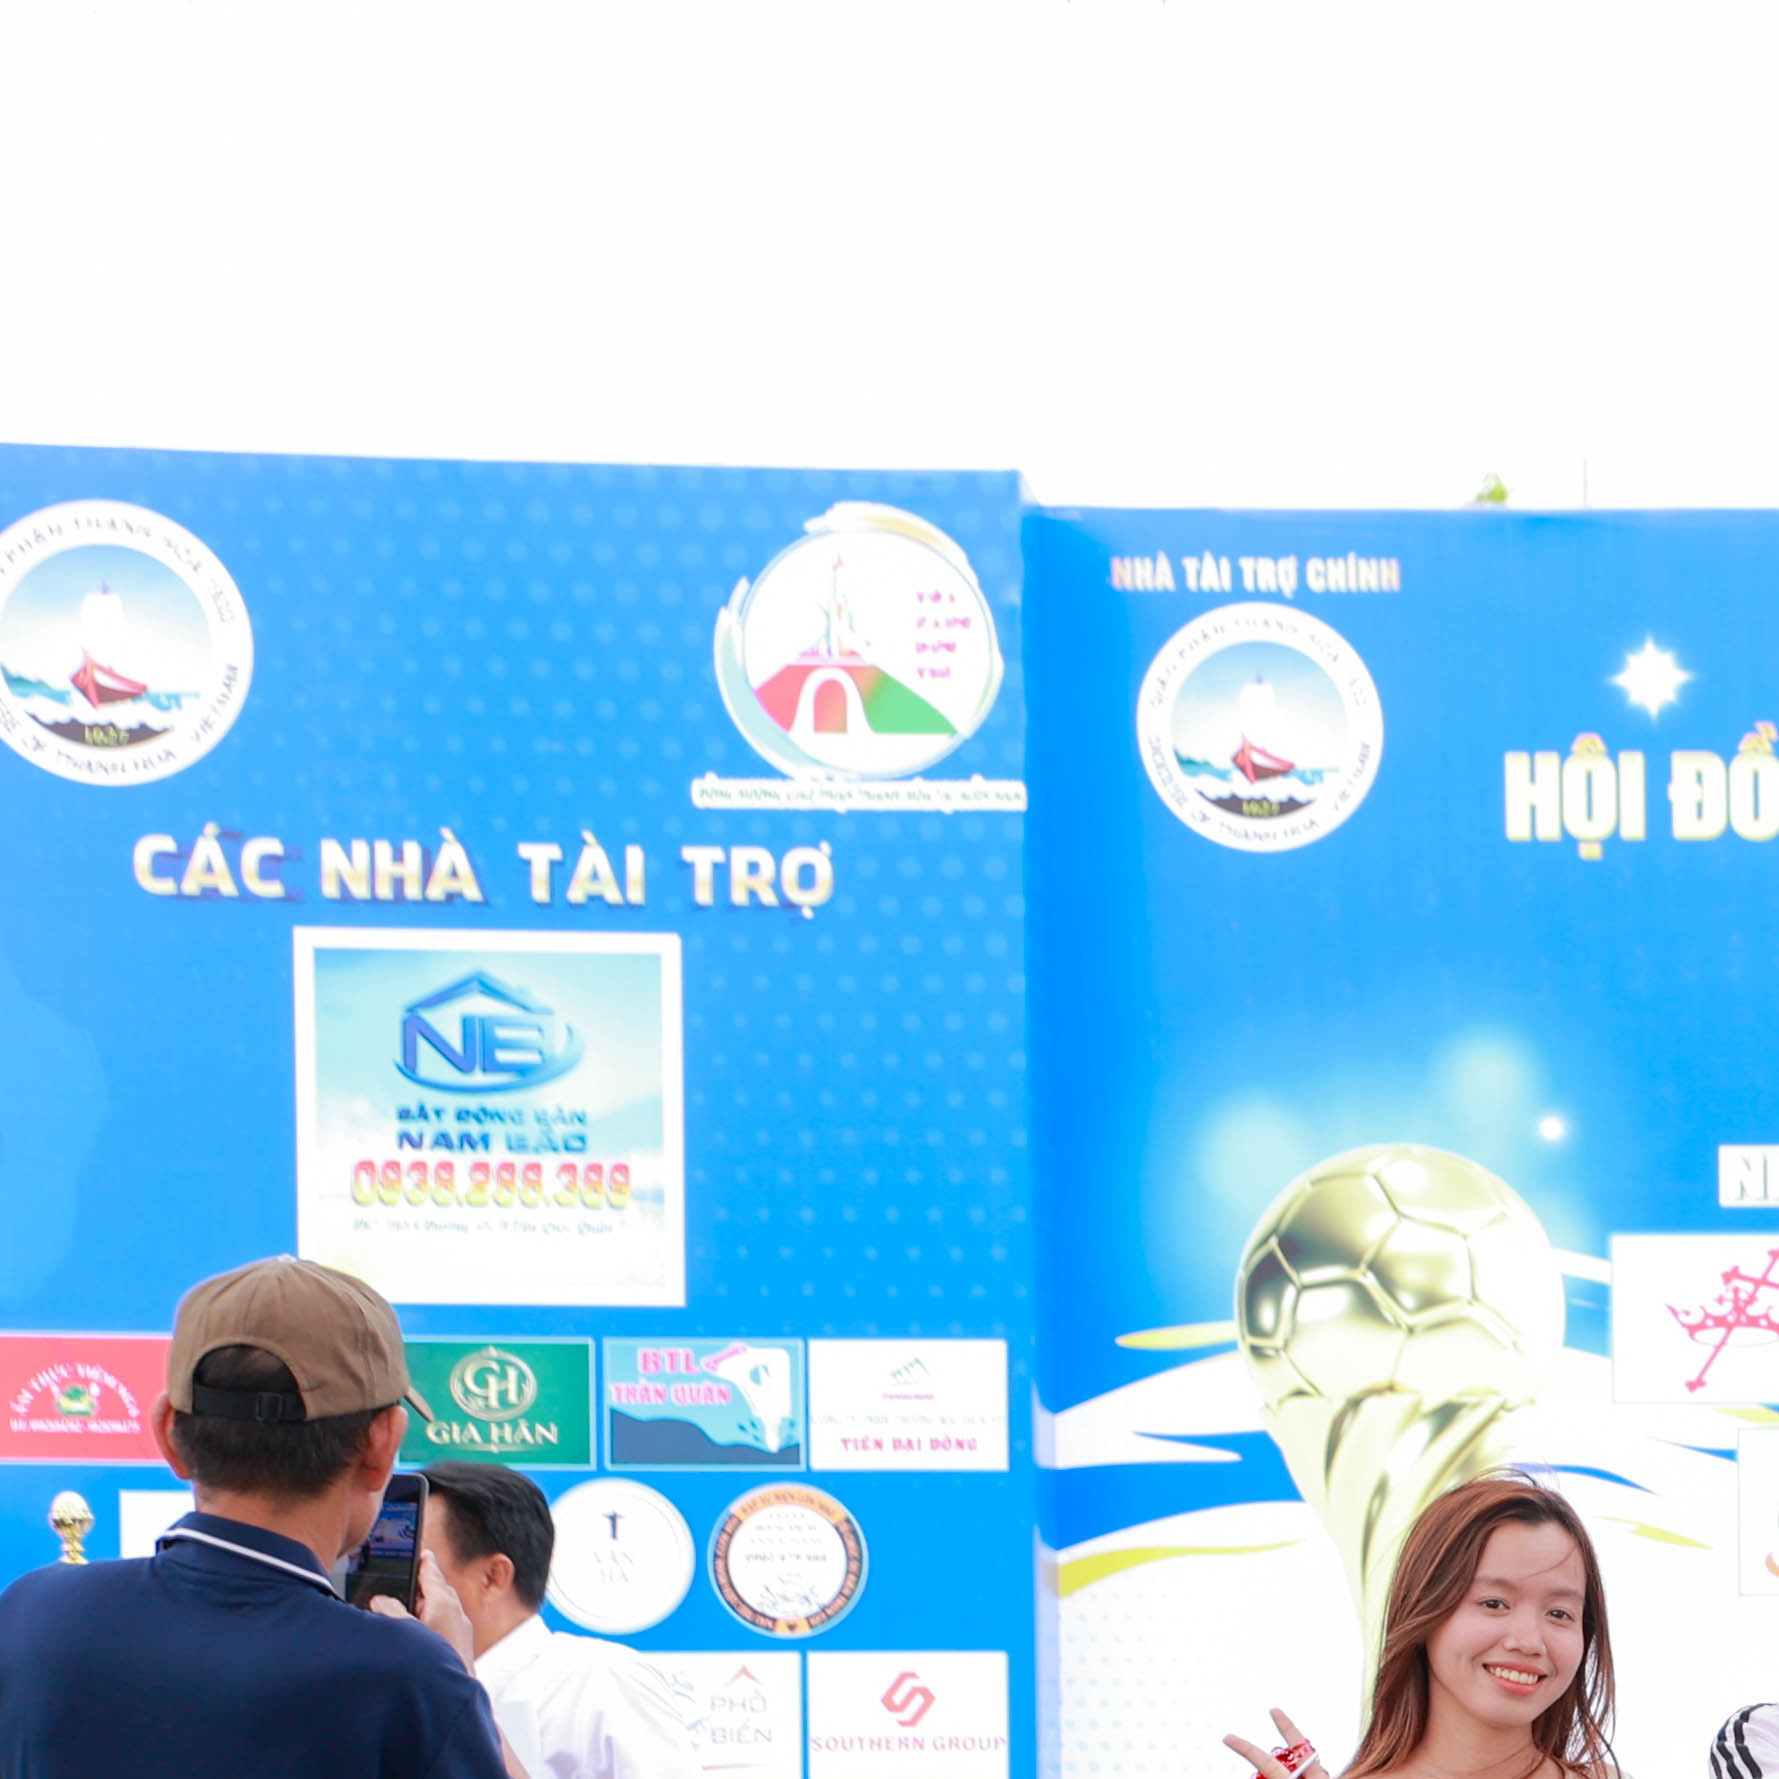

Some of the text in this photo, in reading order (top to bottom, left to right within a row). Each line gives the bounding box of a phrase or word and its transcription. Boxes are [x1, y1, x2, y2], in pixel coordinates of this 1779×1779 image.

[1112, 551, 1400, 597] NHÀ TÀI TRỢ CHÍNH
[1504, 732, 1645, 860] HỘI
[132, 822, 833, 919] CÁC NHÀ TÀI TRỢ
[397, 1131, 490, 1152] NAM
[639, 1350, 701, 1376] BTL
[426, 1419, 481, 1446] GIA
[811, 1735, 1007, 1752] SOUTHERN GROUP
